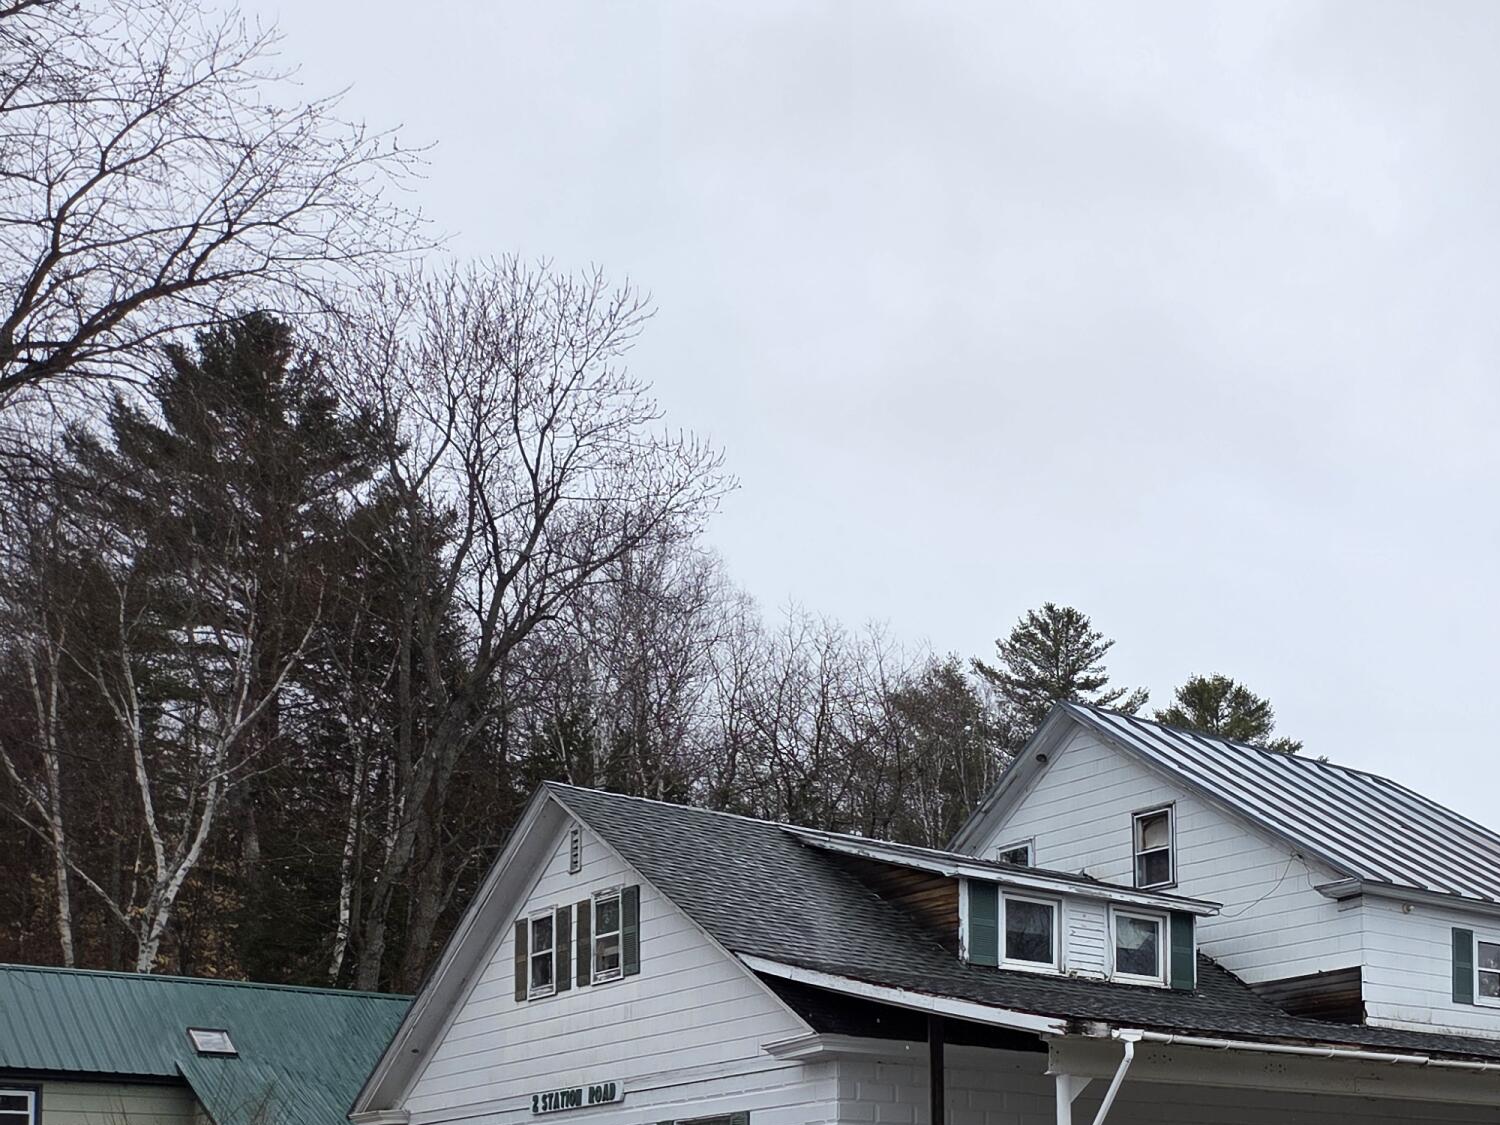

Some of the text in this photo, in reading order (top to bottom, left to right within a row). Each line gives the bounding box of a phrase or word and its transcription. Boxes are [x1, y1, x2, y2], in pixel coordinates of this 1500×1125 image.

[532, 1082, 616, 1113] 2 STATION ROAD
